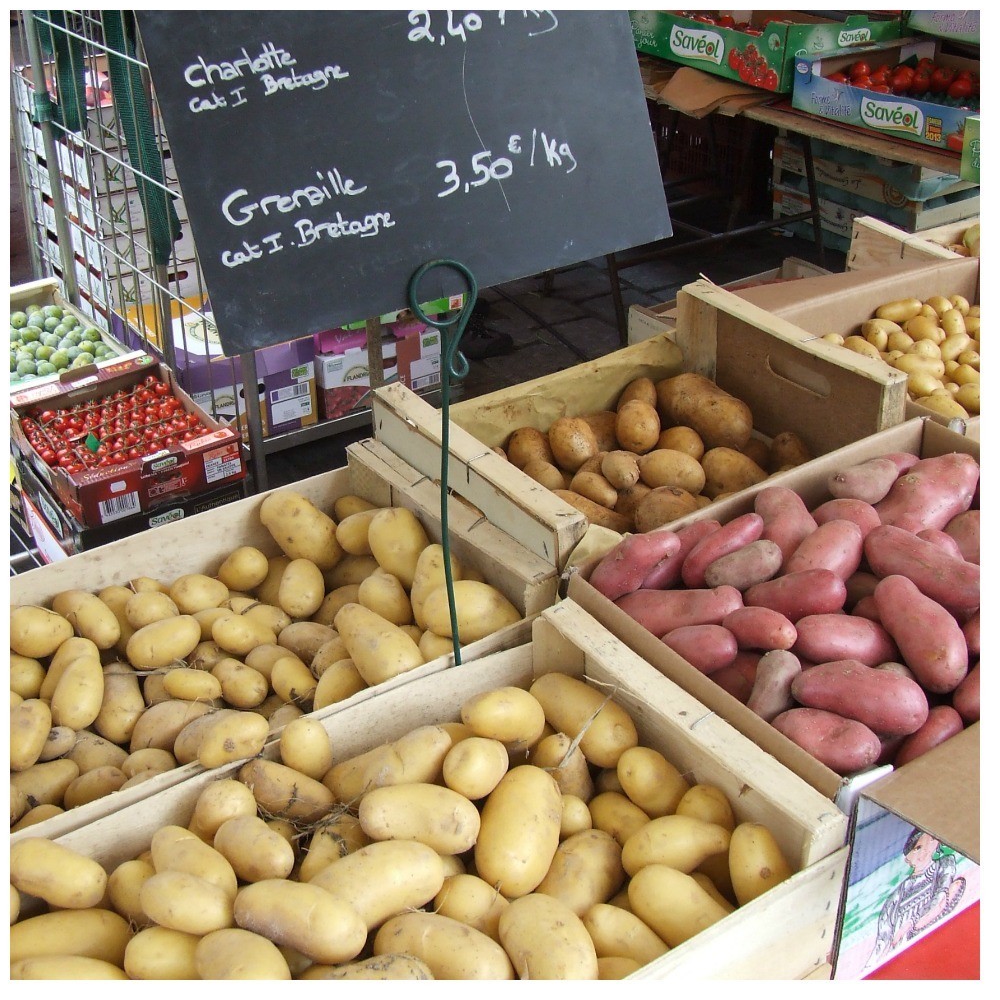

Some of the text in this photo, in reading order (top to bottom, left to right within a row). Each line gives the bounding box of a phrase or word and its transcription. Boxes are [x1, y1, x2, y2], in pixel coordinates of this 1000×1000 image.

[672, 30, 719, 58] Savéol
[840, 30, 868, 43] Savéol
[260, 64, 350, 96] Bretagne
[864, 101, 919, 129] Savéol
[925, 132, 942, 142] 2013
[221, 167, 368, 226] Grenaille
[294, 211, 396, 248] Bretagne
[151, 509, 182, 527] Savéol
